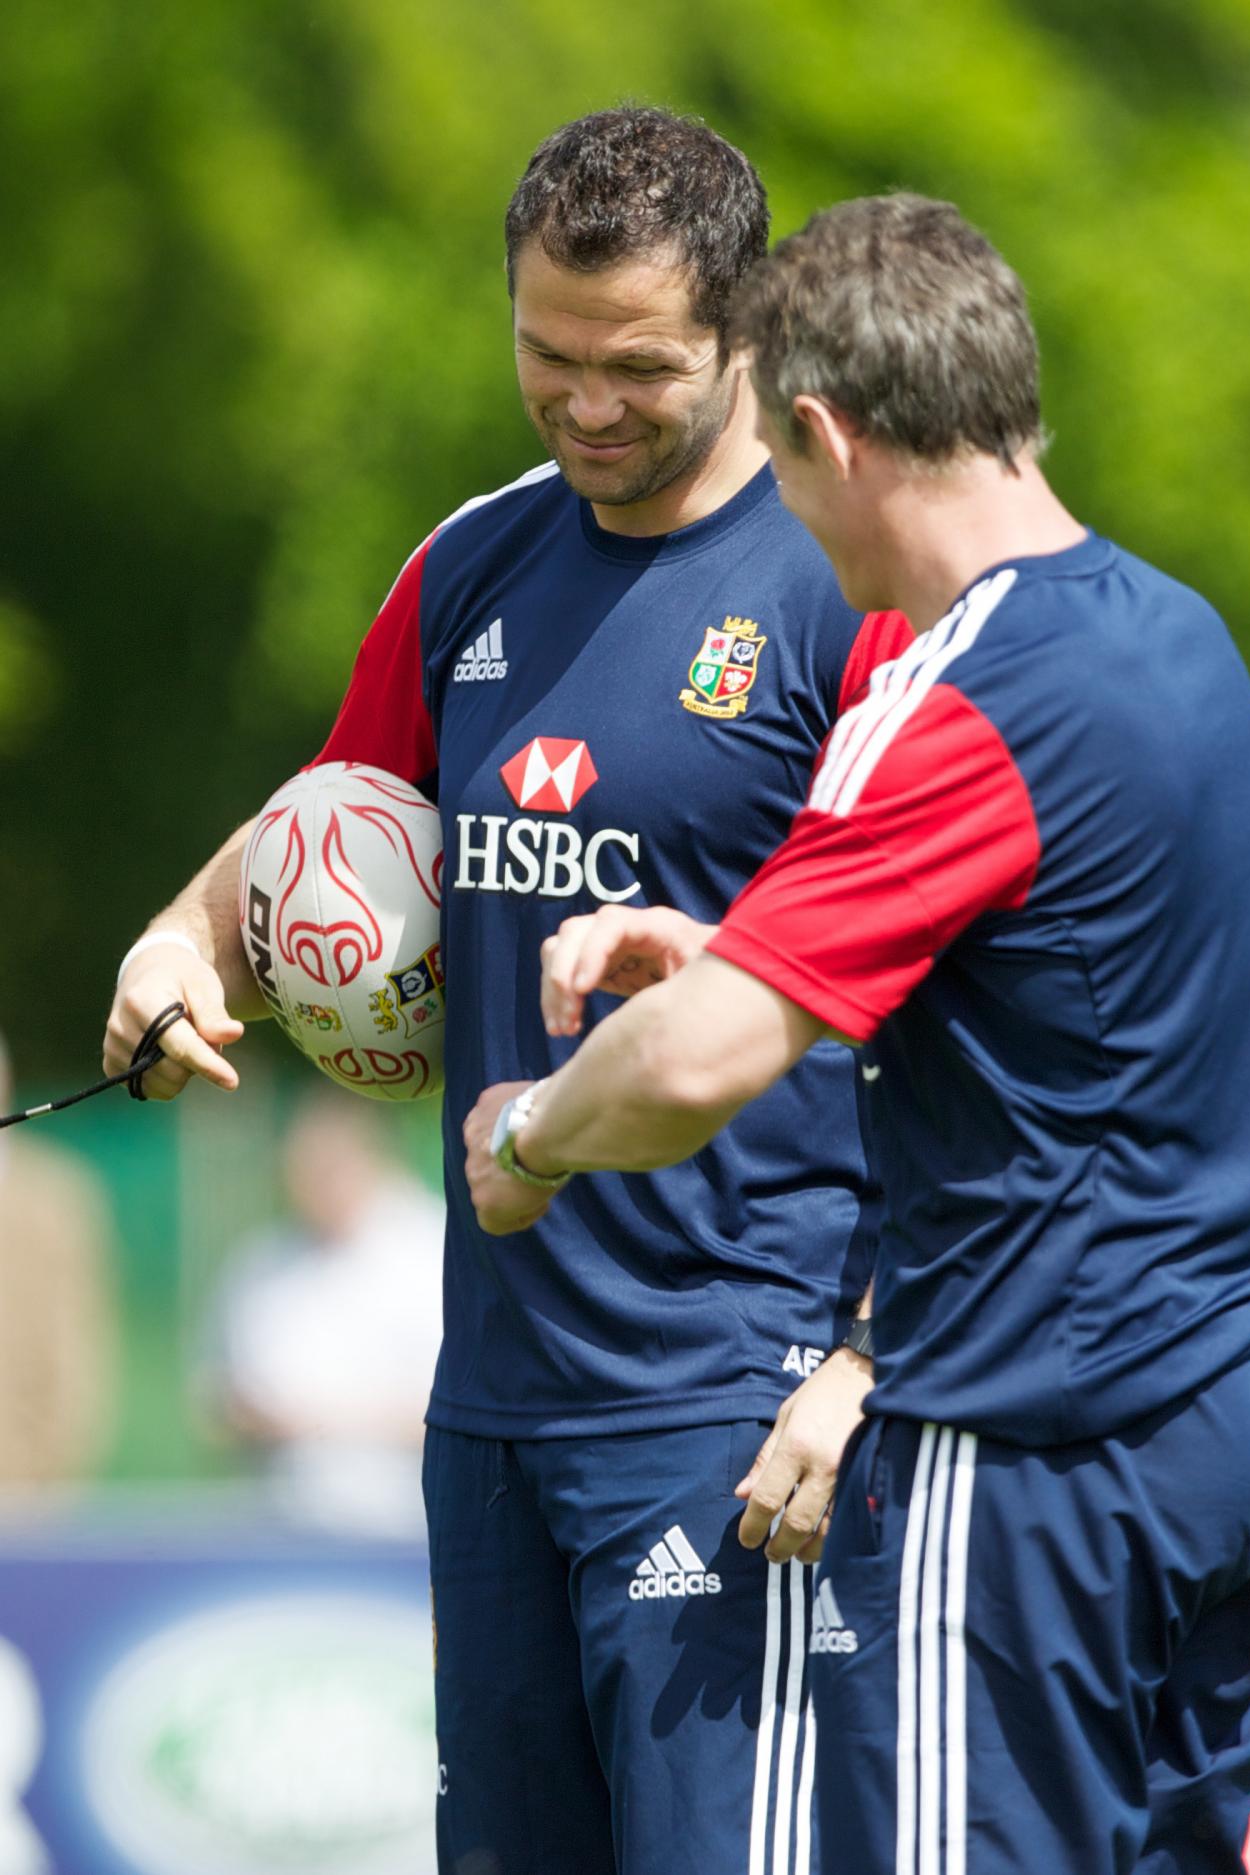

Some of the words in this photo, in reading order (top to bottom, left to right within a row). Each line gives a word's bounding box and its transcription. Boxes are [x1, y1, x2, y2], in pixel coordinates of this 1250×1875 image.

[454, 657, 508, 682] adidas
[454, 814, 641, 903] HSBC
[628, 1569, 722, 1600] adidas
